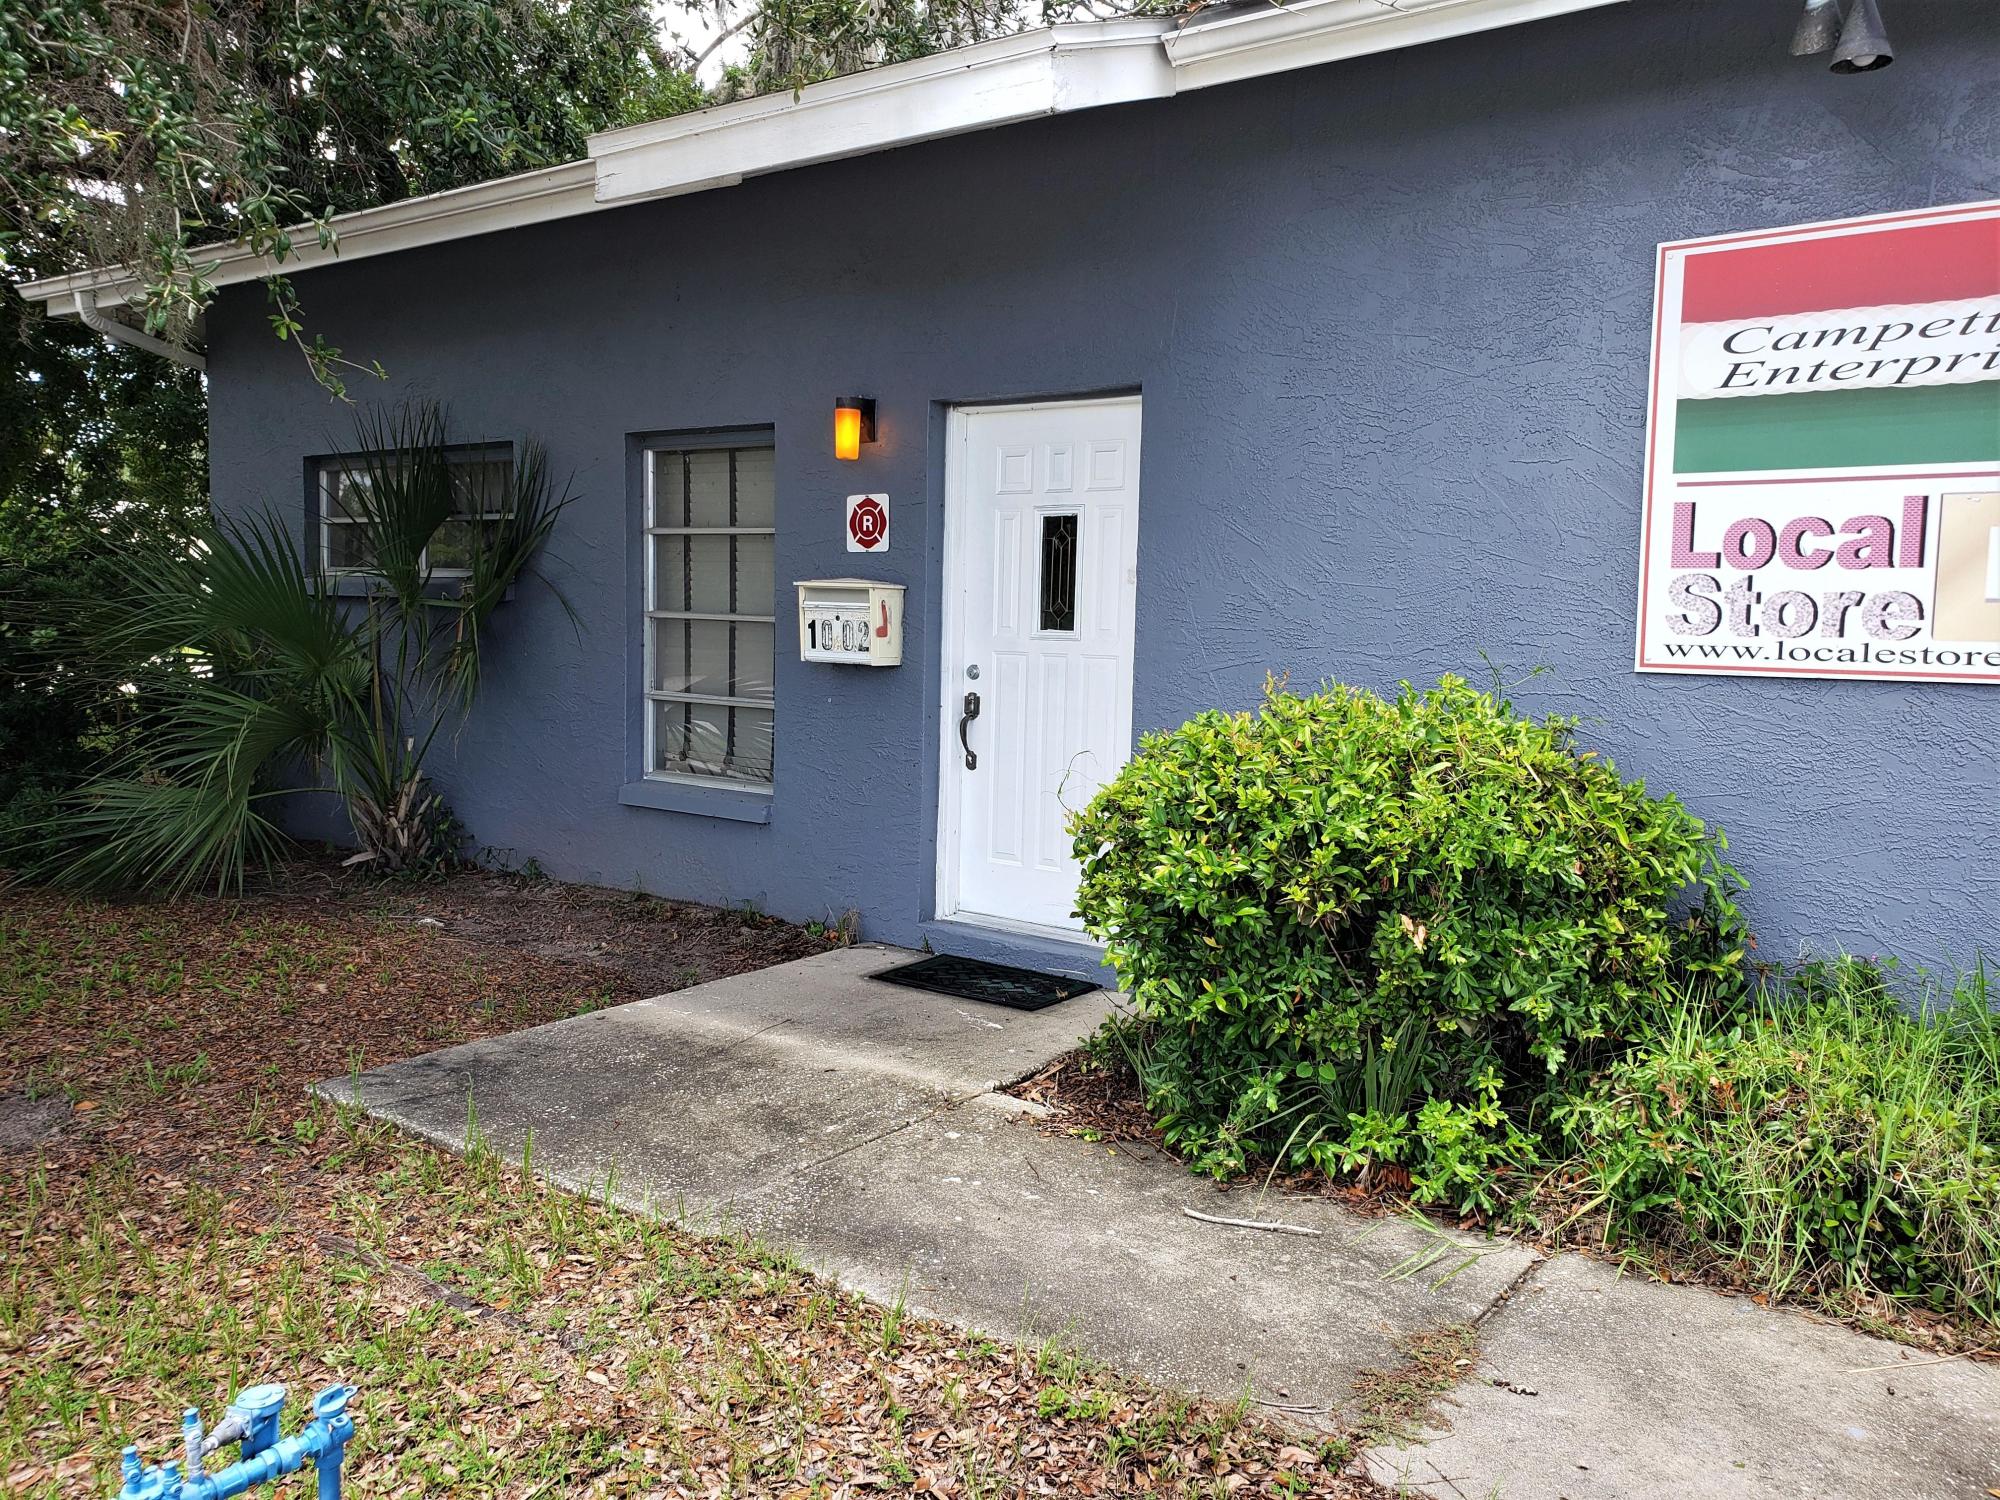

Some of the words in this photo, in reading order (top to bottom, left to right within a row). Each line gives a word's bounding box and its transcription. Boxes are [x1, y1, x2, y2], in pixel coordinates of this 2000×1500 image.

[1714, 343, 2000, 389] Enterpri
[863, 516, 872, 531] R
[1671, 495, 1929, 570] Local
[1665, 573, 1925, 640] Store
[1664, 641, 2000, 667] www.localestore
